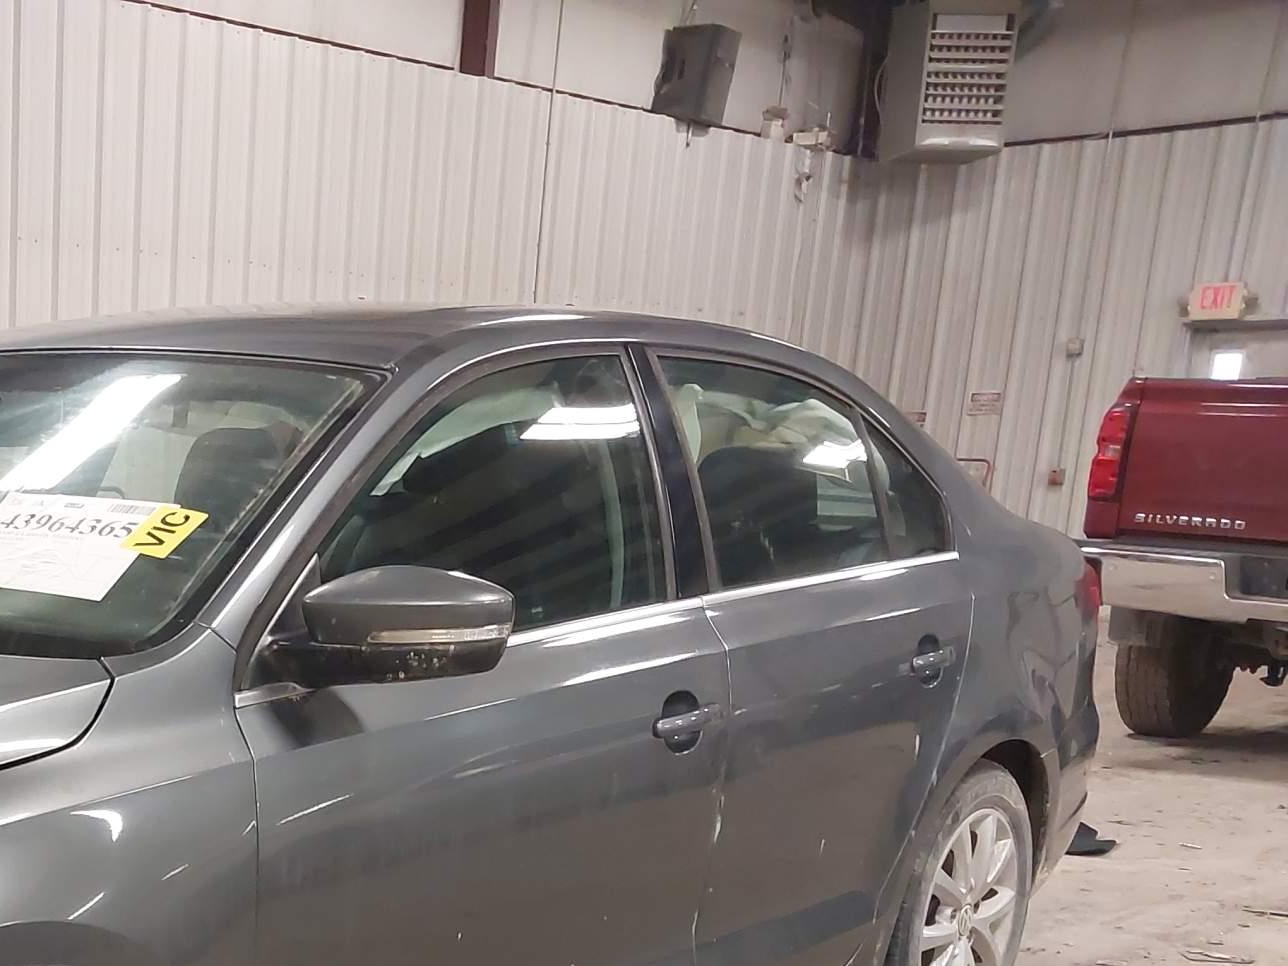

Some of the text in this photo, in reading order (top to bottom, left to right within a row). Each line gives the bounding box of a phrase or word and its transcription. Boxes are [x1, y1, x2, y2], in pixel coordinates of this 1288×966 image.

[1200, 286, 1235, 310] EXIT
[0, 513, 139, 538] 43964365
[133, 511, 191, 548] VIC
[1135, 513, 1246, 530] SILVERADO
